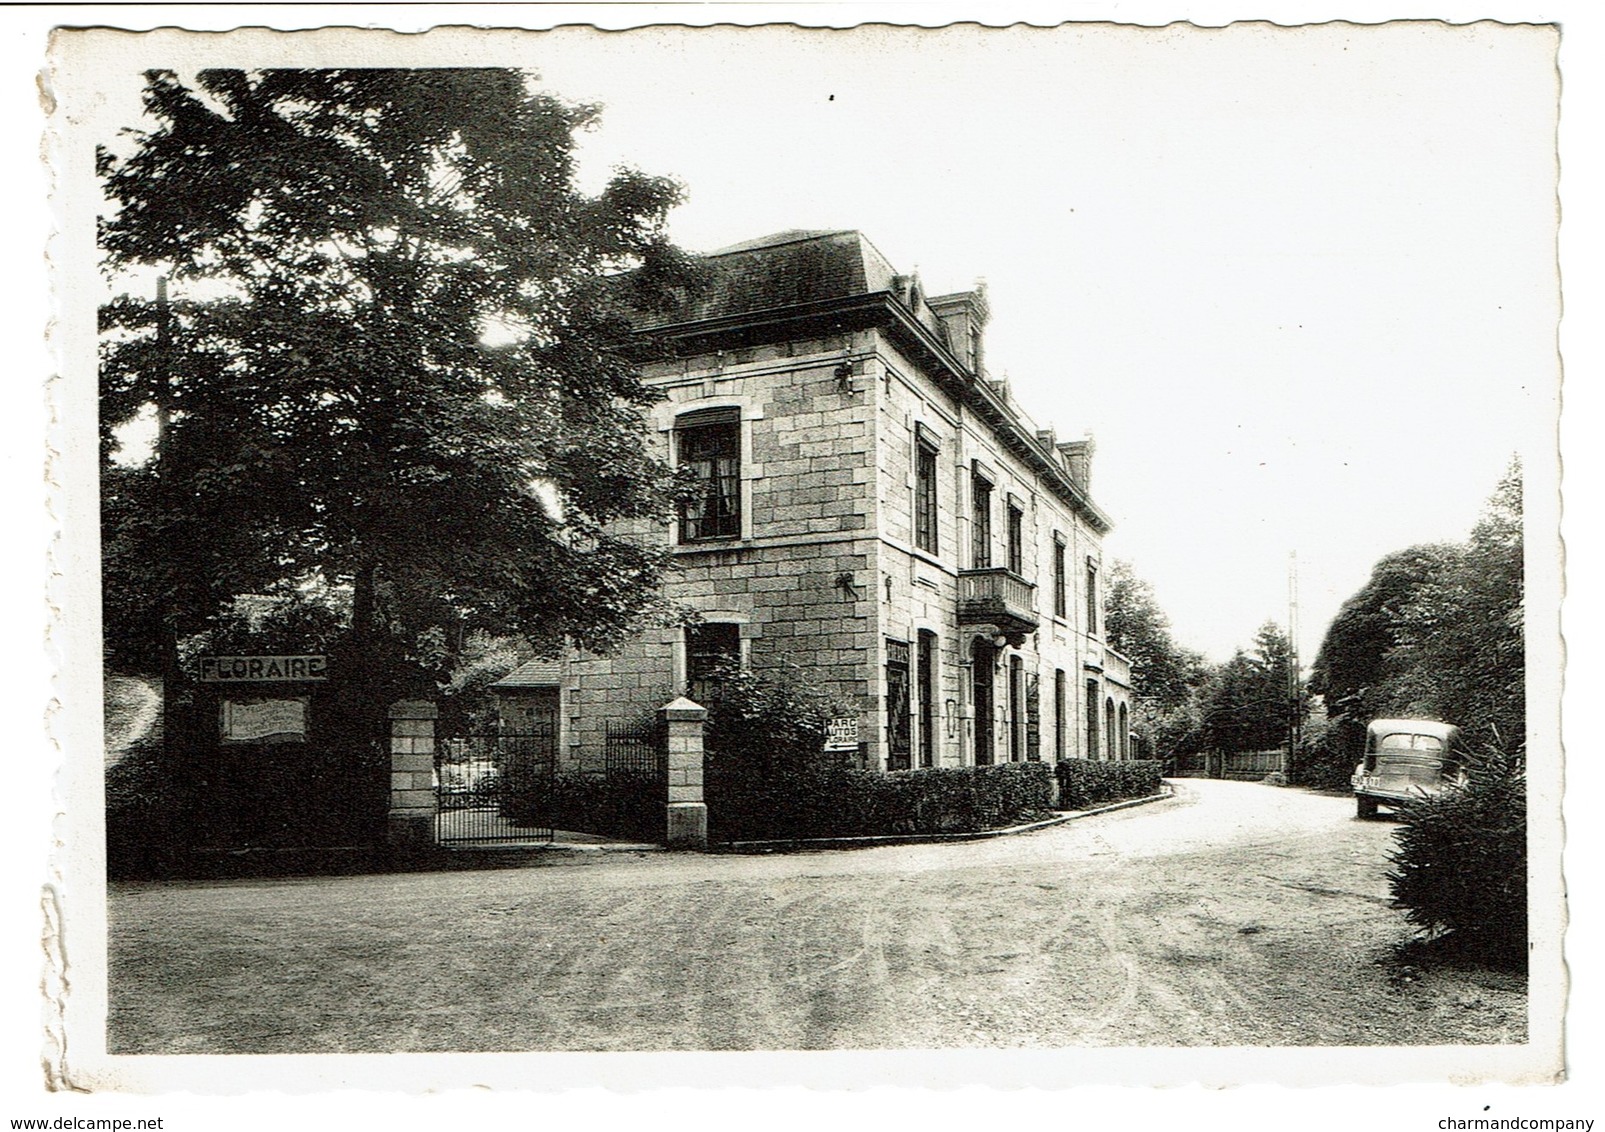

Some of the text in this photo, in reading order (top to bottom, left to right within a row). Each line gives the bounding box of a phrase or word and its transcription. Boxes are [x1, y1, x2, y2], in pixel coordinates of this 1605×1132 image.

[201, 658, 326, 679] FLORAIRE
[826, 718, 857, 728] PARC
[825, 727, 857, 736] AUTOS
